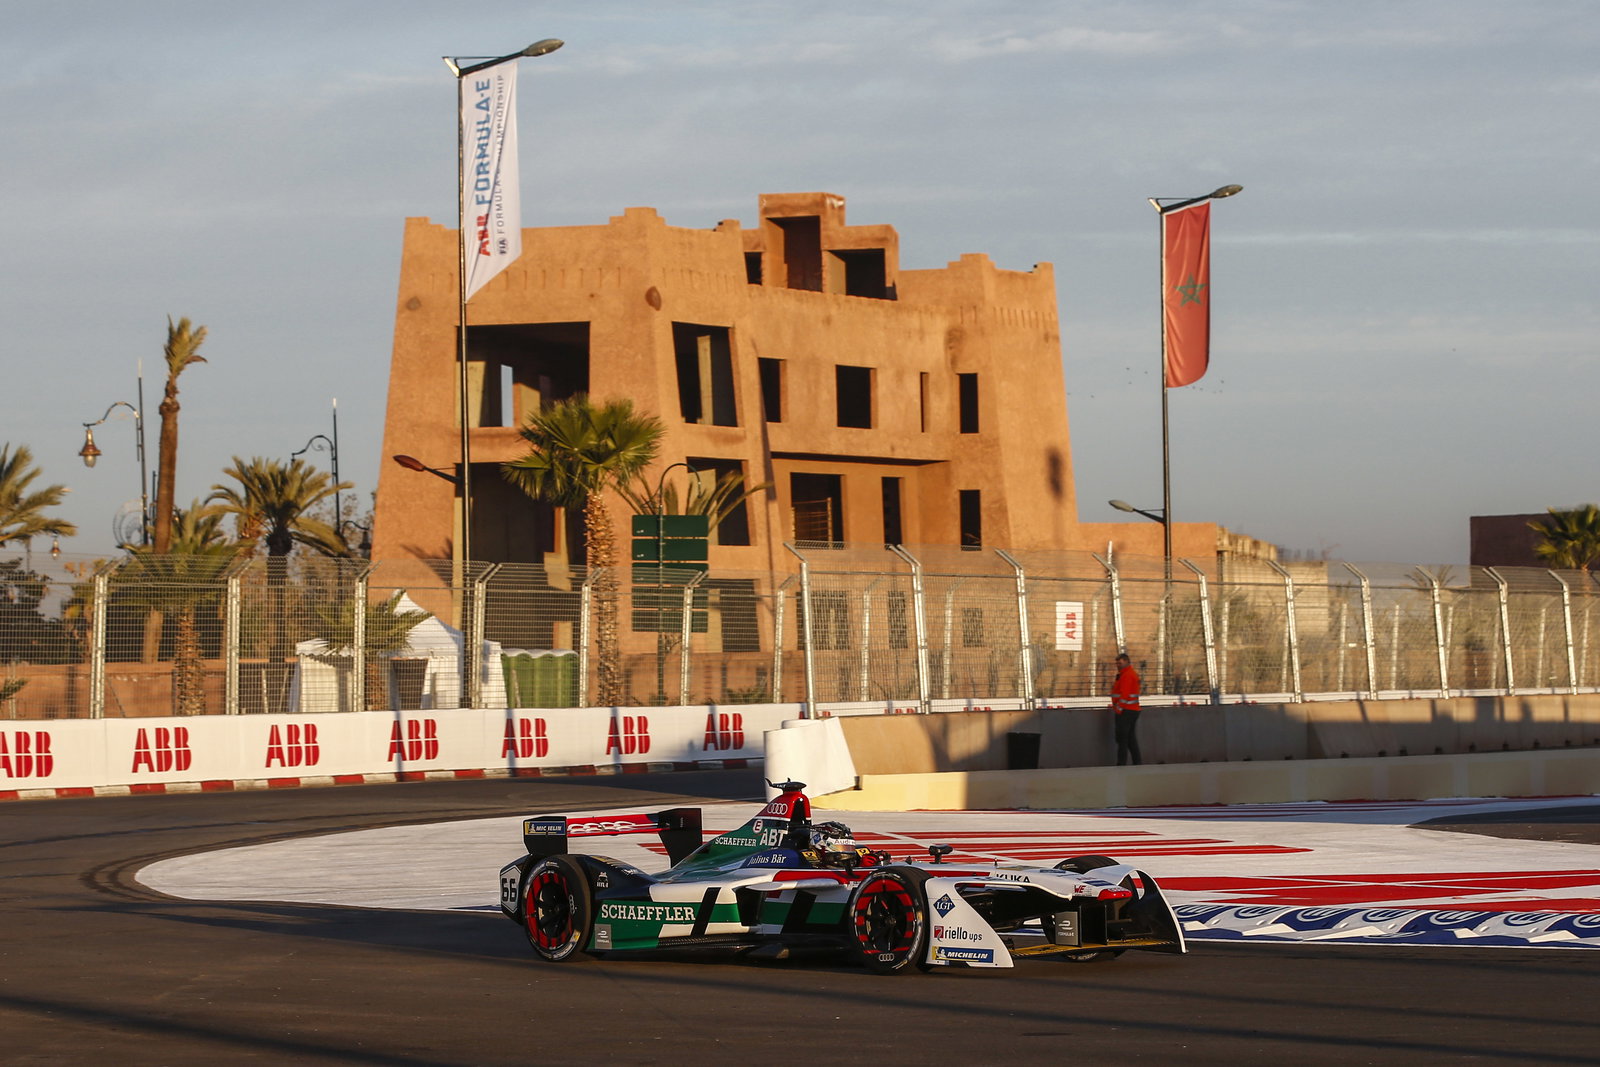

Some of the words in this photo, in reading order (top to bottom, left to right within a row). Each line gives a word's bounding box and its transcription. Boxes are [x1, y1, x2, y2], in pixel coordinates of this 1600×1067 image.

[1065, 612, 1076, 640] ABB
[387, 719, 439, 762] ABB
[501, 718, 548, 758] ABB
[606, 716, 650, 755] ABB
[703, 713, 744, 751] ABB
[131, 727, 192, 773] ABB
[265, 723, 320, 768] ABB
[715, 837, 756, 847] SCHAEFFLER
[759, 828, 788, 846] ABT
[747, 854, 769, 867] Julius
[771, 853, 787, 864] Bär
[501, 877, 517, 902] 66
[601, 904, 696, 921] SCHAEFFLER
[937, 901, 953, 910] LGT
[945, 926, 967, 940] riello
[969, 933, 982, 942] ups
[947, 951, 988, 959] MICHELIN
